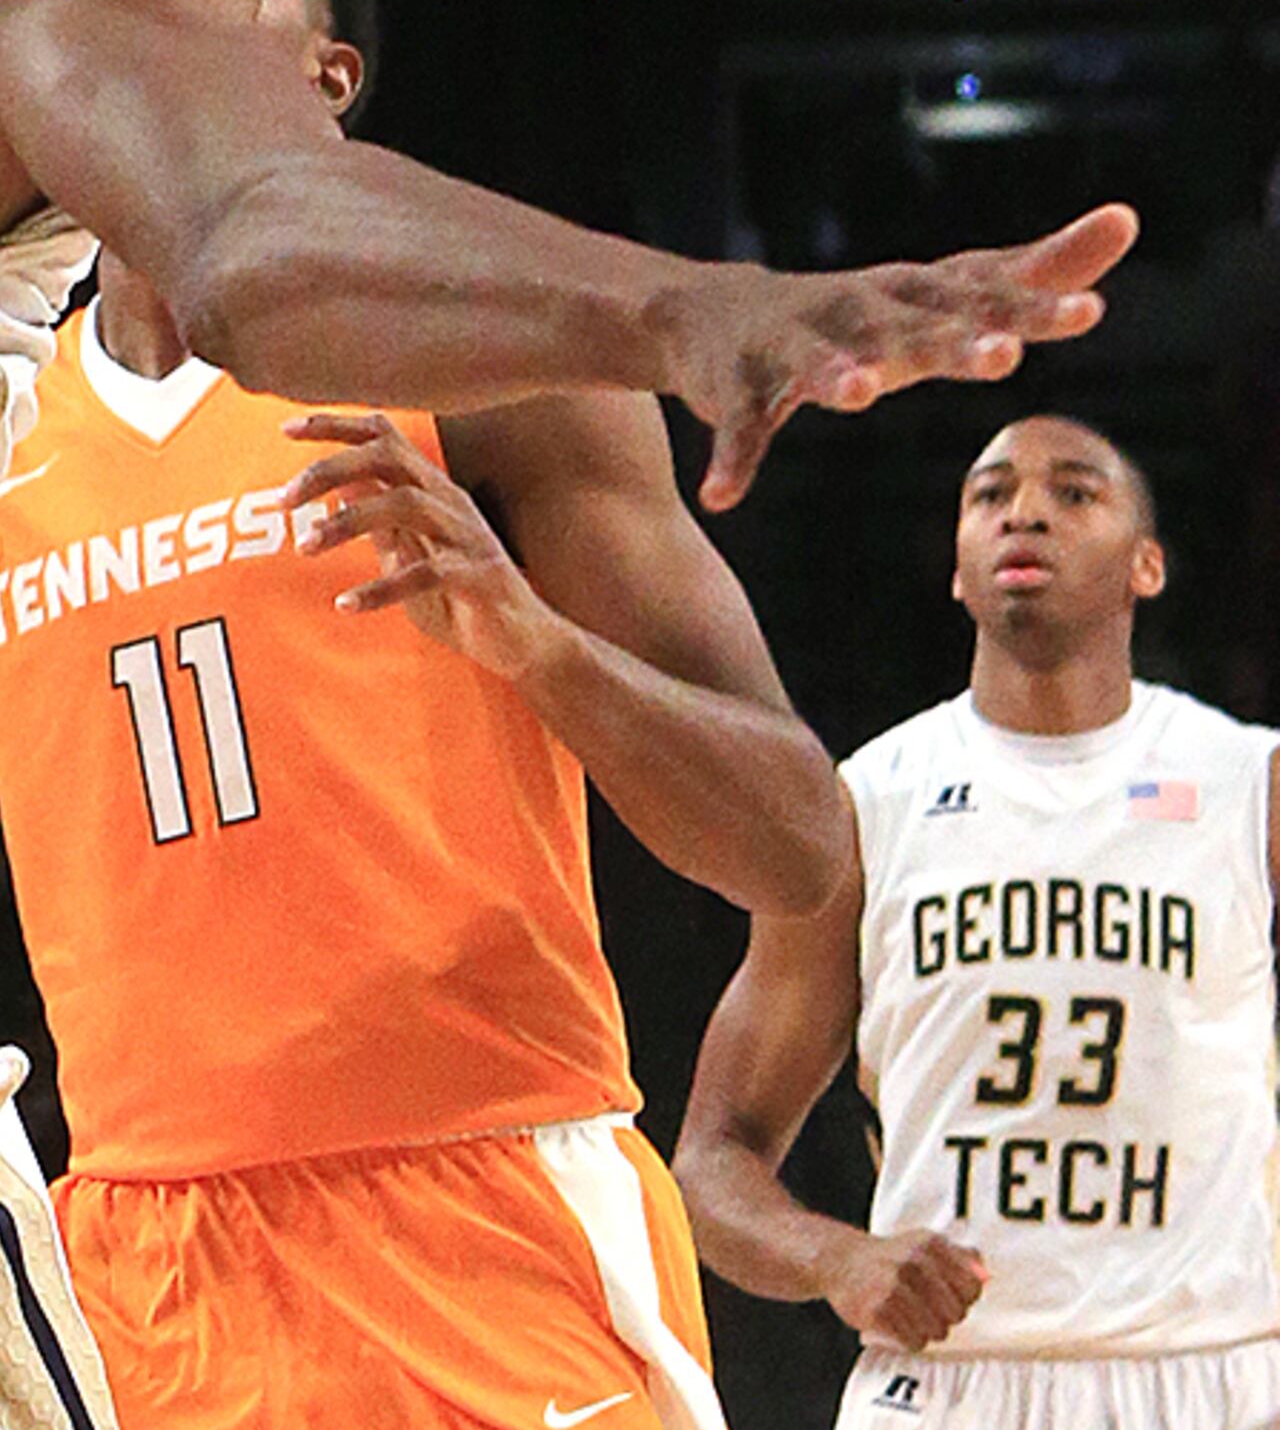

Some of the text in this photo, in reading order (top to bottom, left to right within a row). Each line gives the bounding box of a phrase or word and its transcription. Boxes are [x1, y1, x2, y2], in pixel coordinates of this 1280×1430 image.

[109, 615, 261, 845] 11
[912, 877, 1197, 982] GEORGIA
[973, 993, 1129, 1110] 33
[942, 1135, 1171, 1228] TECH
